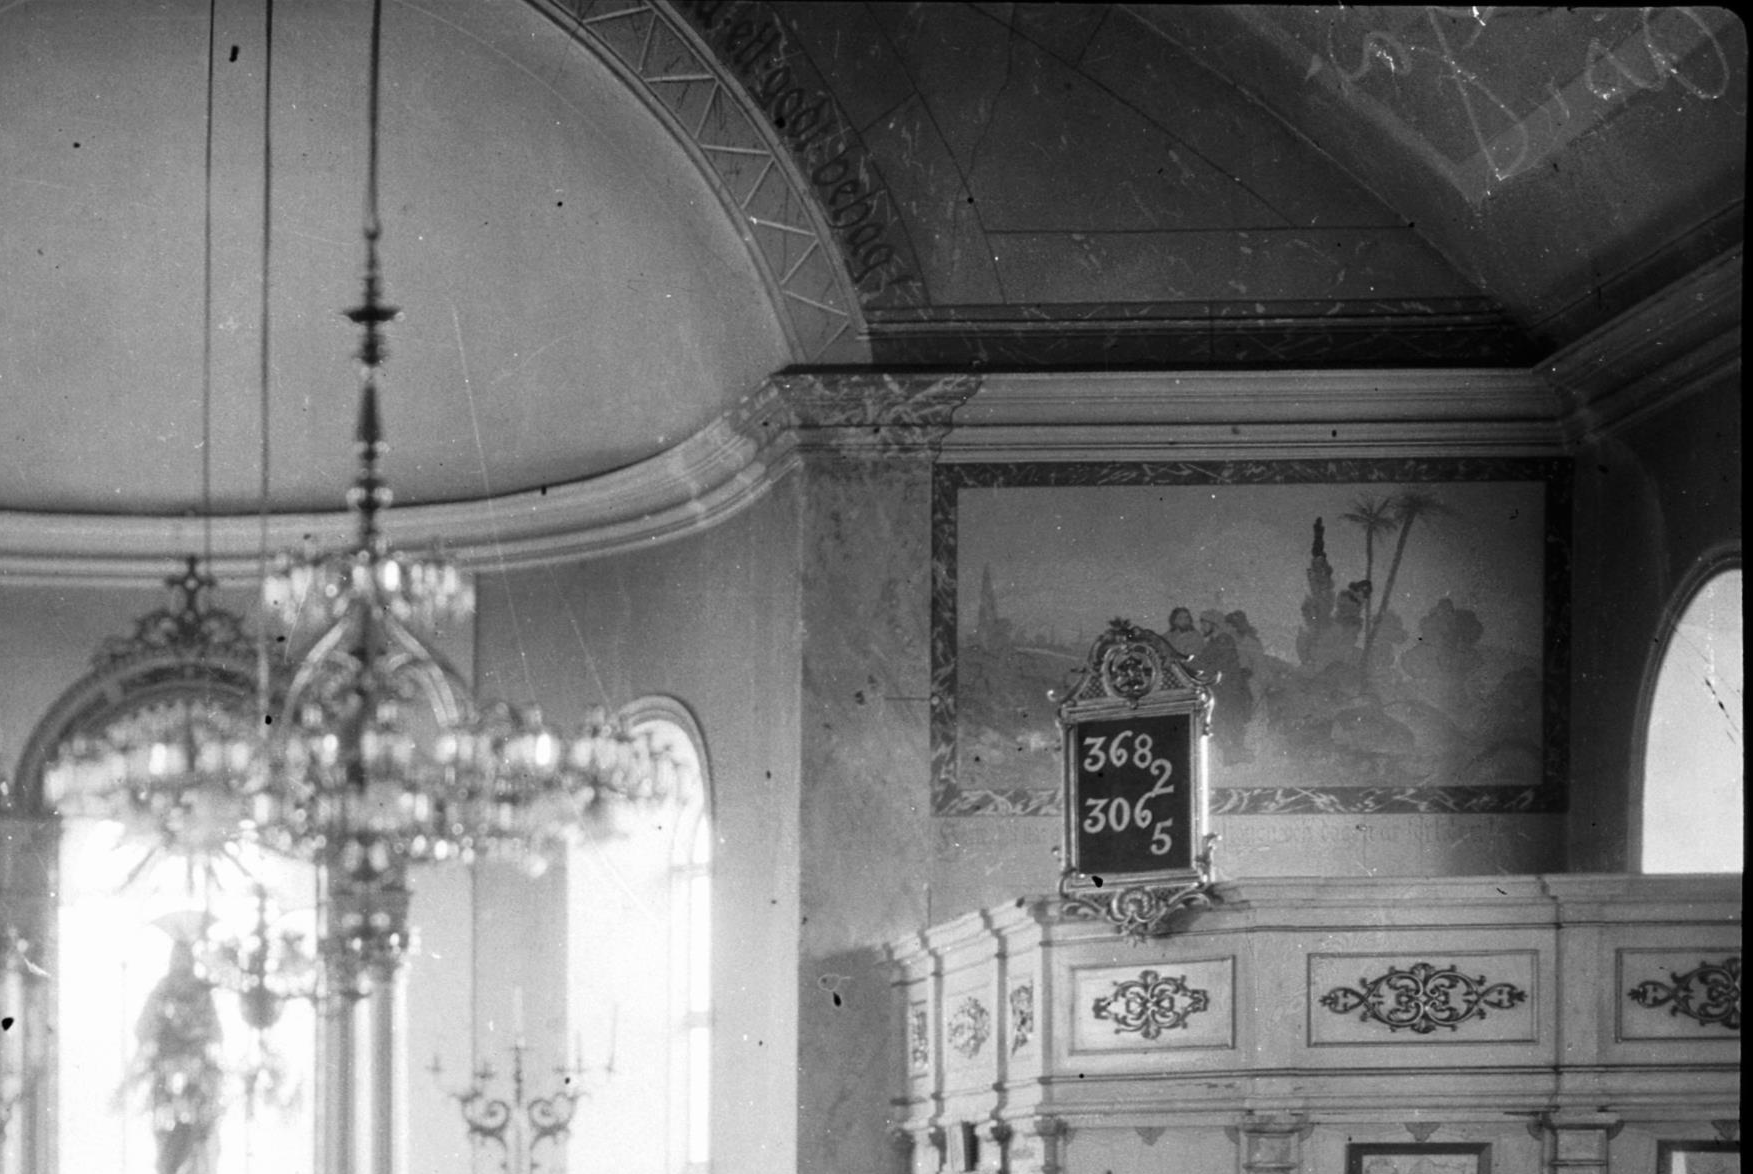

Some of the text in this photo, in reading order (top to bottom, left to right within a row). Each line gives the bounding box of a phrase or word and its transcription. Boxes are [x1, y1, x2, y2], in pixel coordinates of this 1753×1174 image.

[1082, 730, 1175, 796] 368 2
[1082, 793, 1153, 834] 306
[1150, 818, 1174, 856] 5
